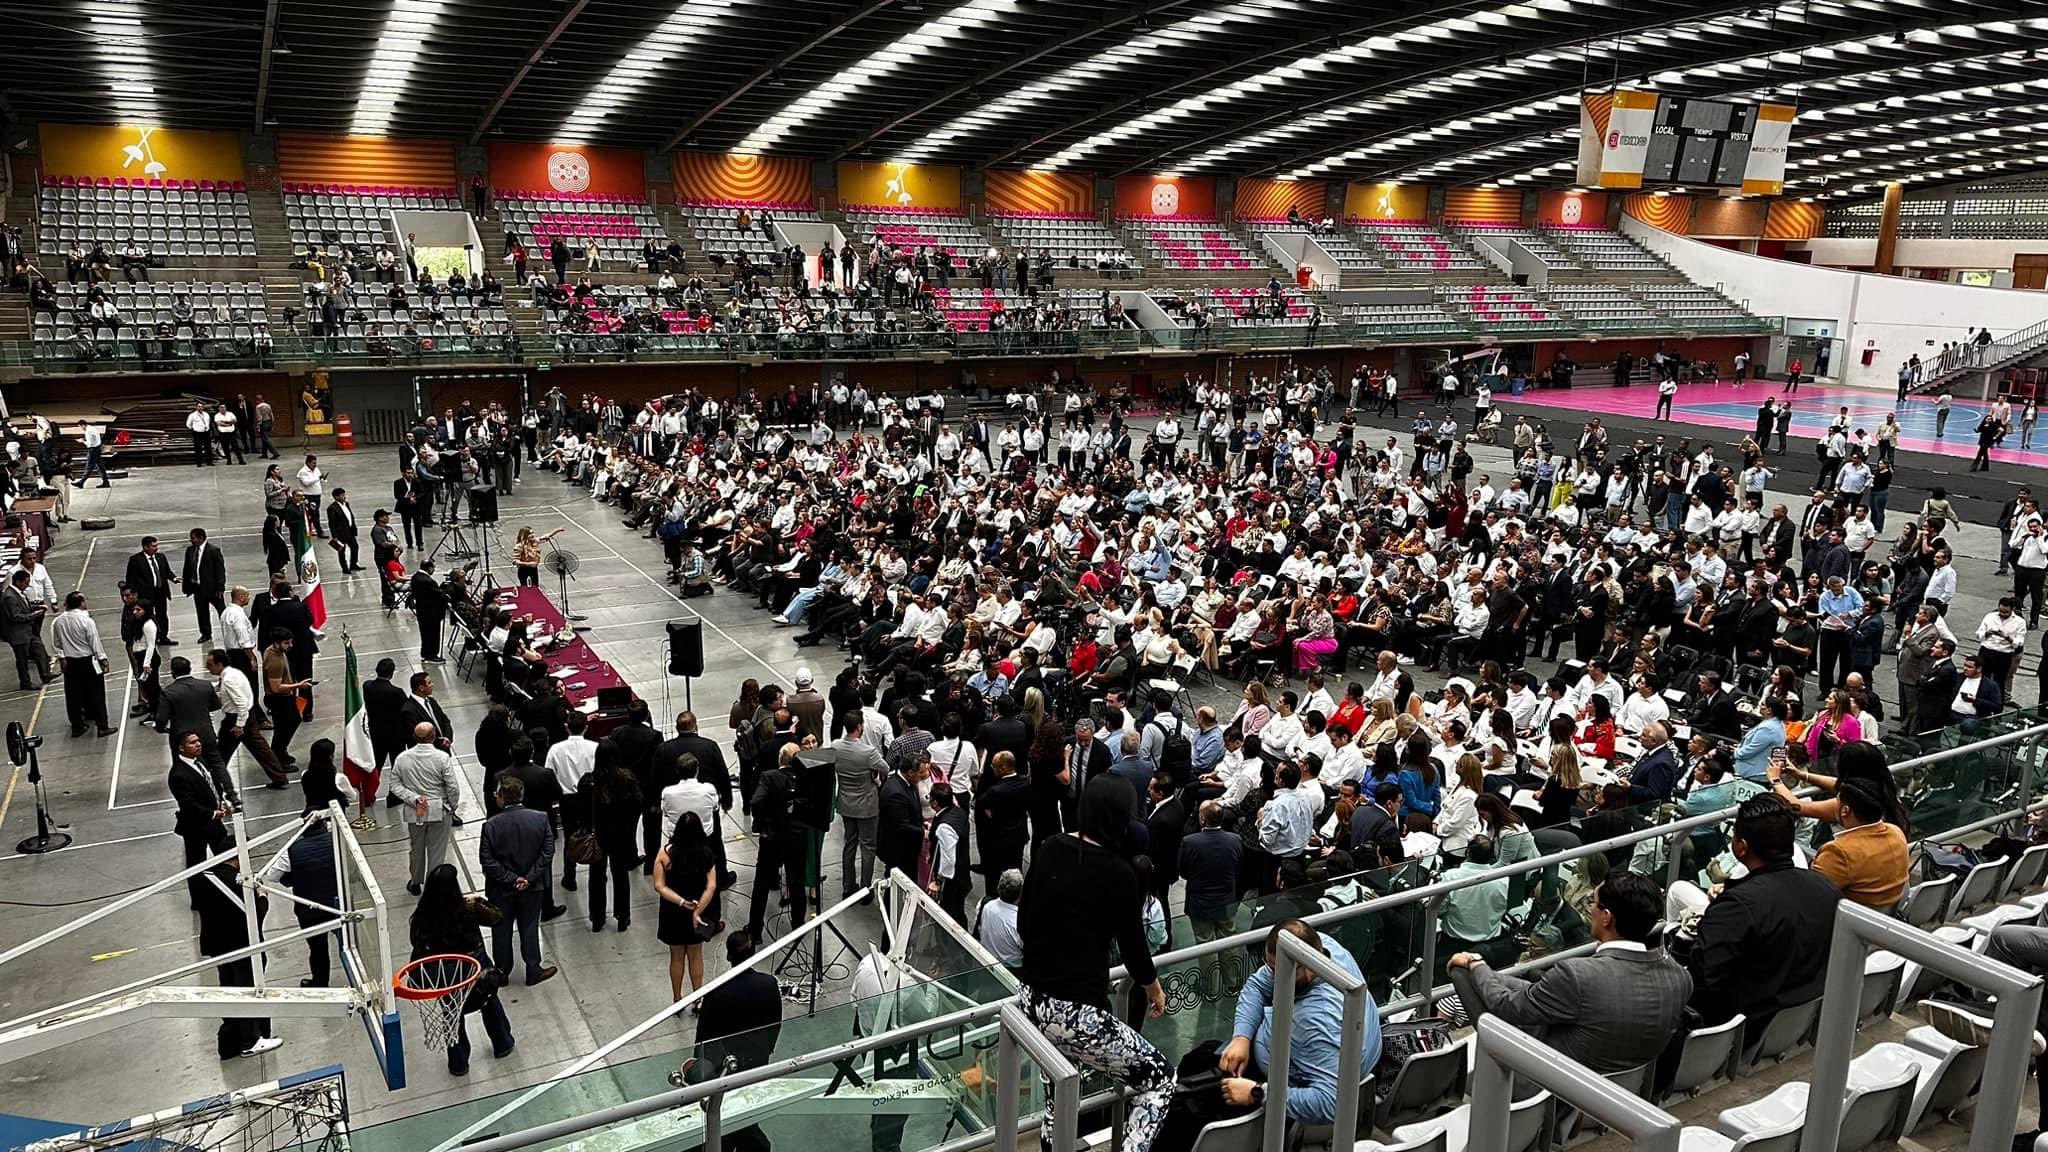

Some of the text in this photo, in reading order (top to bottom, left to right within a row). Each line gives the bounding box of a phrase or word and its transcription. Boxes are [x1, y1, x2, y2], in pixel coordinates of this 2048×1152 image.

[1655, 126, 1674, 135] LOCAL
[1694, 128, 1713, 136] TIEMPO
[1730, 132, 1749, 141] VISITA
